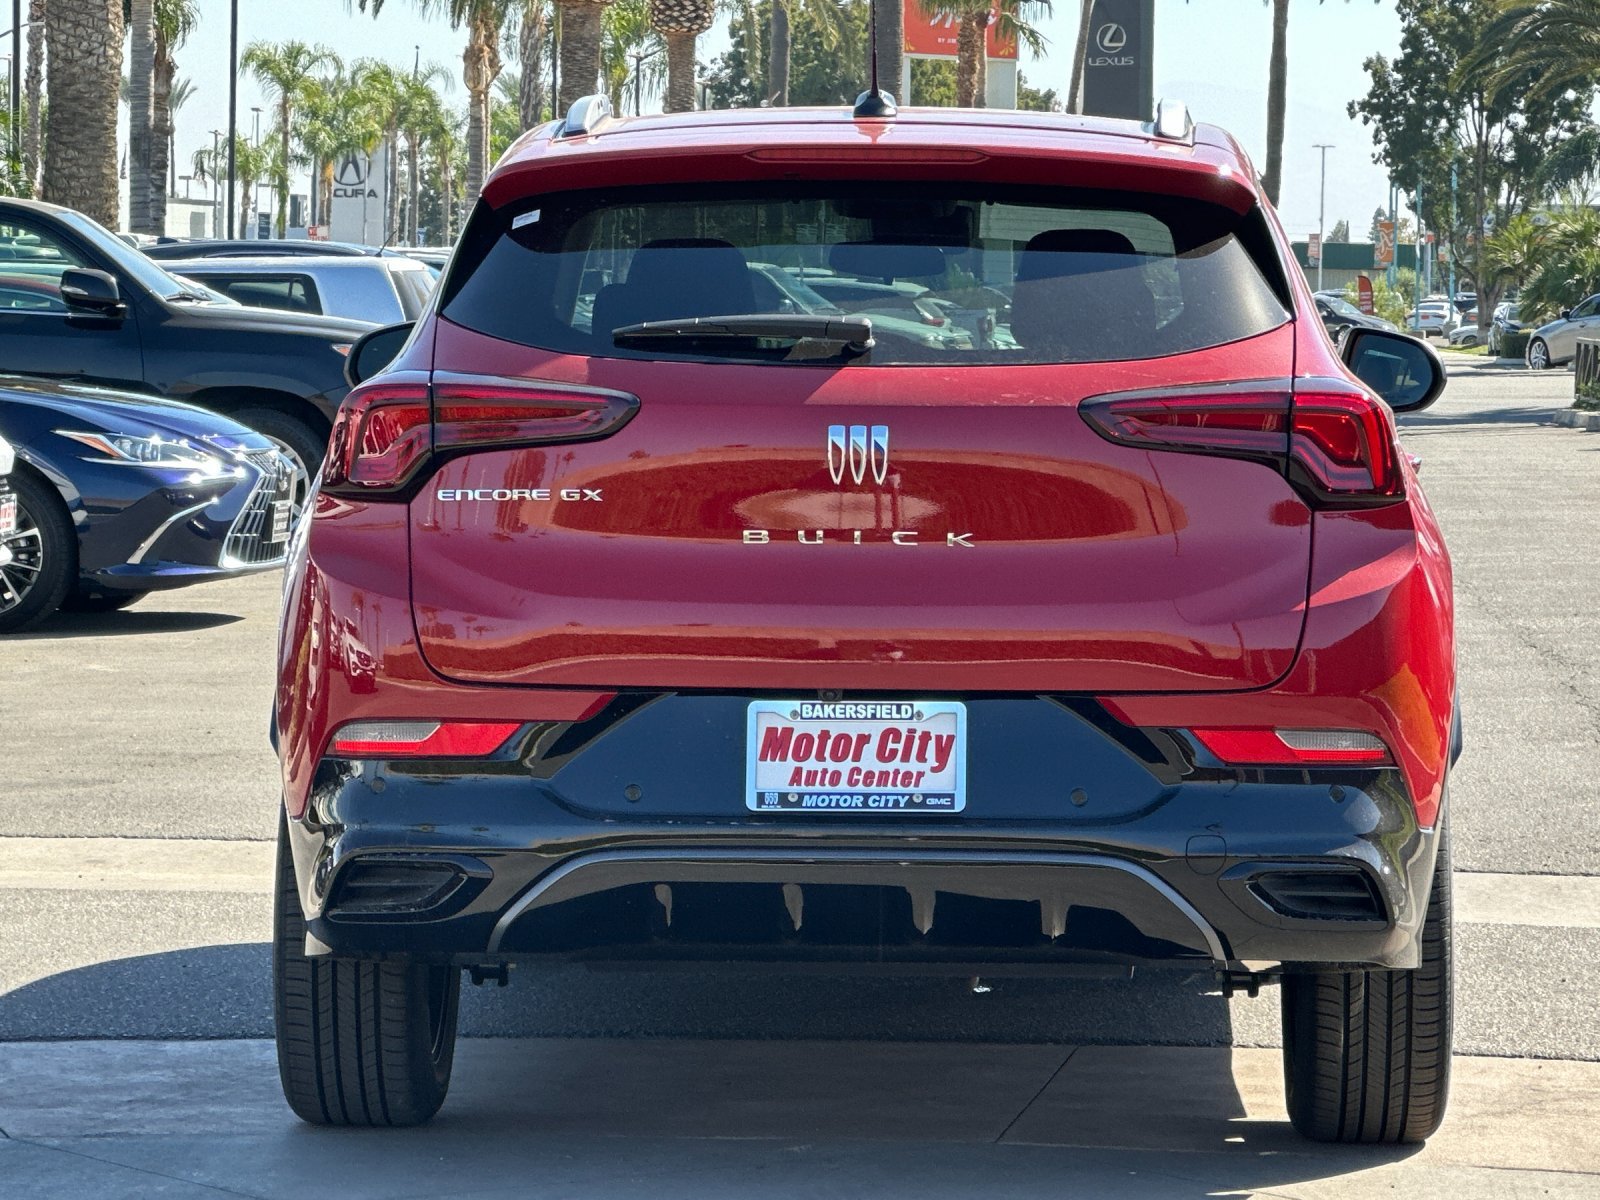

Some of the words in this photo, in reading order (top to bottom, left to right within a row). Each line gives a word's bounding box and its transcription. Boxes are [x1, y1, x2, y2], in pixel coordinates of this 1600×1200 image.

[1088, 56, 1135, 66] LEXUS
[332, 188, 378, 199] CURA
[437, 489, 551, 501] ENCORE
[560, 489, 603, 502] GX
[742, 530, 975, 548] BUICK
[801, 704, 912, 719] BAKERSFIELD
[758, 727, 871, 763] Motor
[876, 727, 955, 773] City
[788, 766, 842, 787] Auto
[847, 766, 925, 788] Center
[802, 795, 863, 807] MOTOR
[867, 795, 909, 807] CITY
[926, 797, 951, 805] GMC
